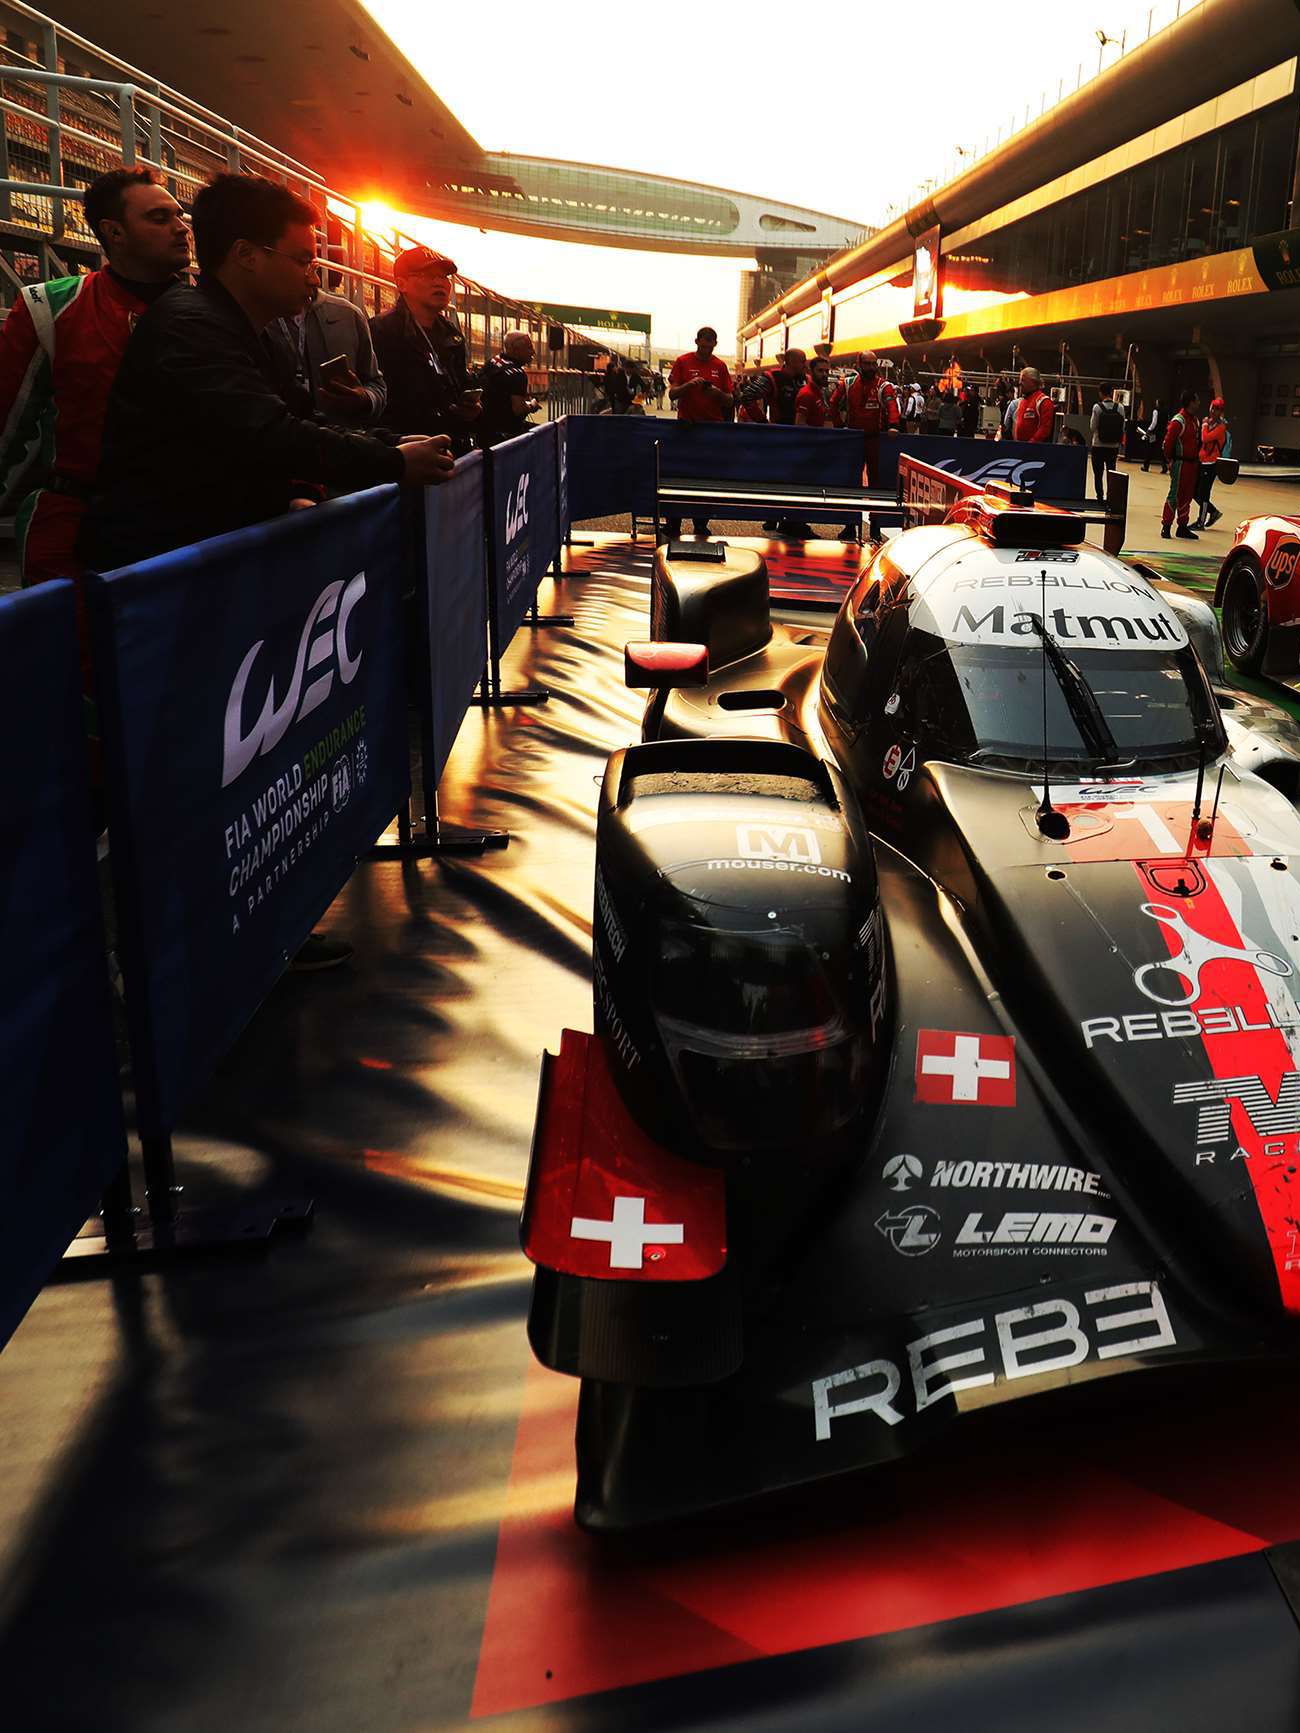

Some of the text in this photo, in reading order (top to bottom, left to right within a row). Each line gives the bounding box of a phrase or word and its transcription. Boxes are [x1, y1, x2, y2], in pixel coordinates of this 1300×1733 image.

[1192, 283, 1216, 298] ROLEX
[1227, 276, 1254, 293] ROLEX
[505, 472, 530, 545] WEC
[1271, 550, 1295, 580] ups
[953, 575, 1155, 601] REBELLION
[952, 604, 1182, 642] Matmut
[223, 570, 368, 788] WEC
[225, 704, 367, 859] FIA WORLD ENDURANCE
[1079, 785, 1158, 797] WEC
[229, 773, 328, 896] CHAMPIONSHIP
[232, 811, 330, 935] A PARTNERSHIP
[707, 857, 852, 884] mouser.com
[930, 1160, 1102, 1196] NORTHWIRE
[953, 1212, 1121, 1245] LEMO
[952, 1247, 1108, 1258] MOTORSPORT CONNECTORS
